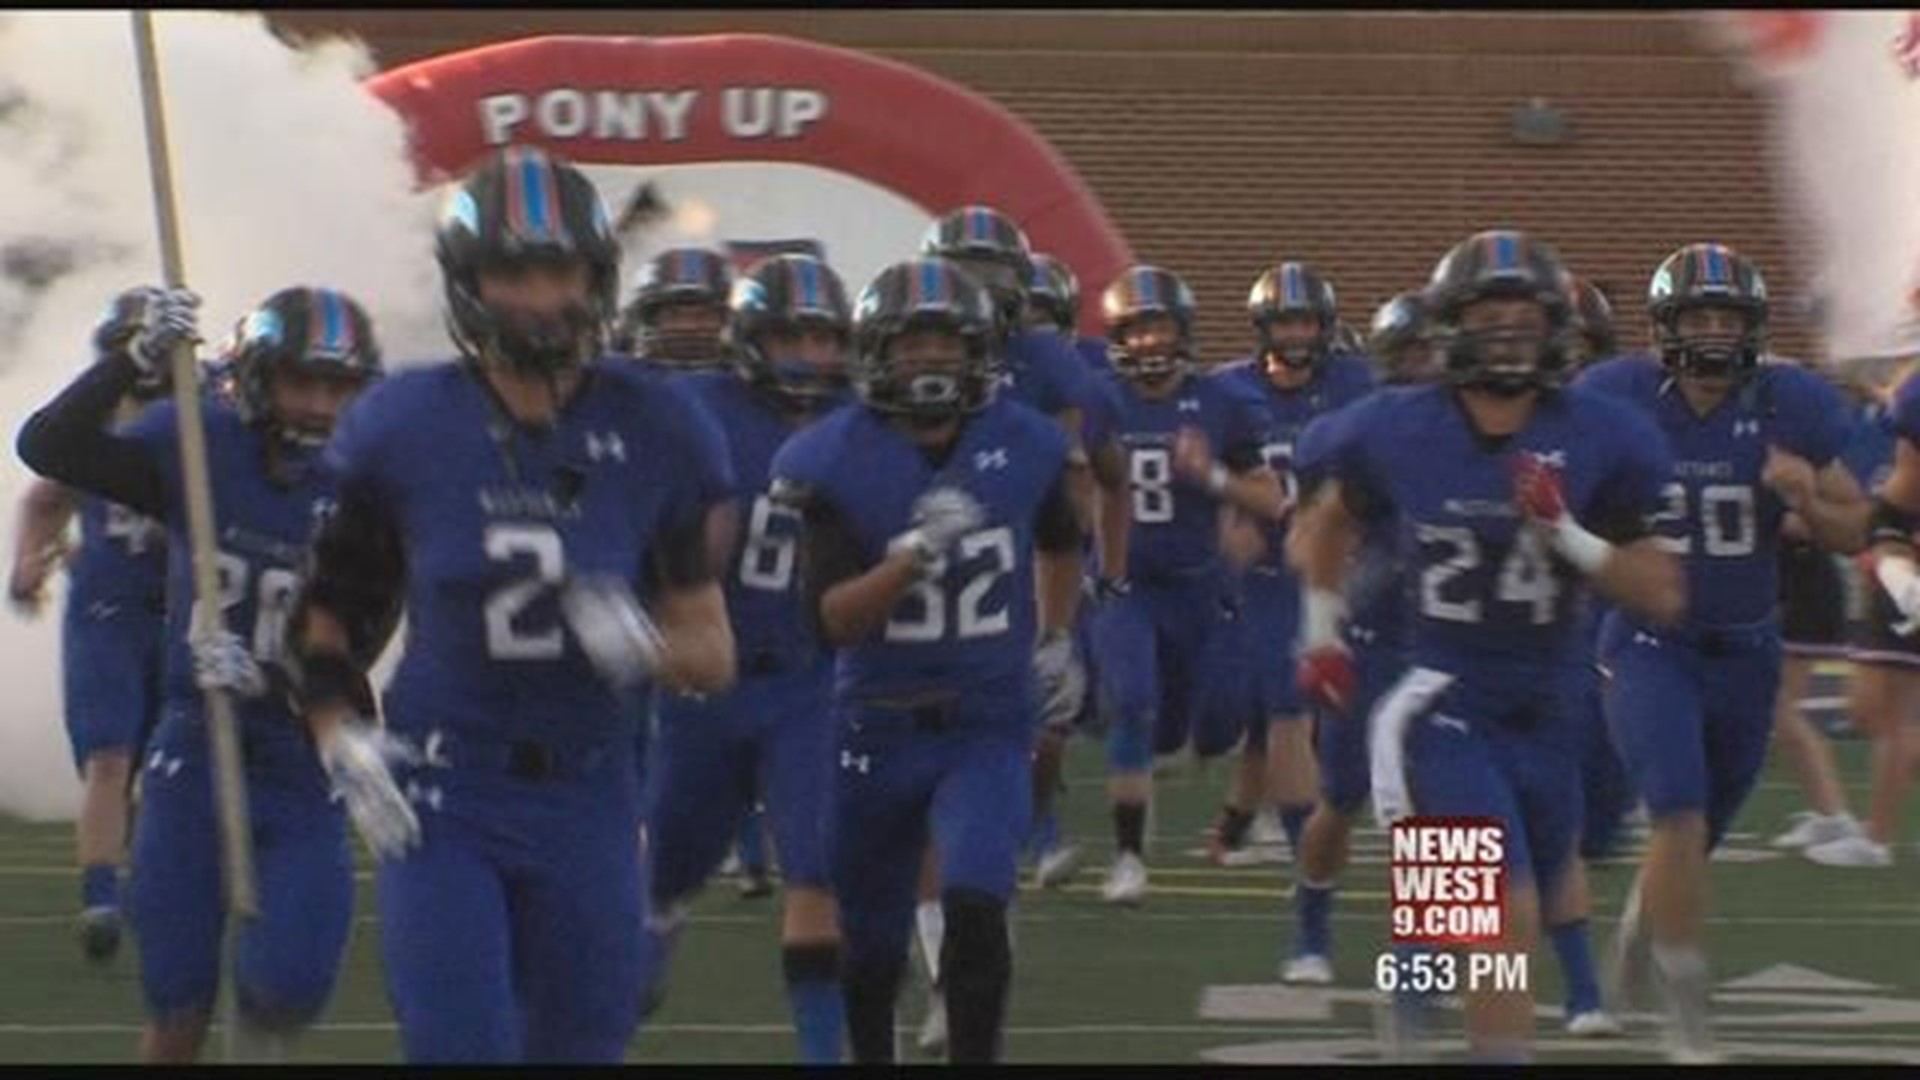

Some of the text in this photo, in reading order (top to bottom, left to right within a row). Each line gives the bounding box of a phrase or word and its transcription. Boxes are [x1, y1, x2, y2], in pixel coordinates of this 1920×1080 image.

[480, 87, 826, 144] PONY UP
[1131, 450, 1174, 522] 8
[484, 525, 563, 659] 2
[1414, 523, 1558, 625] 24
